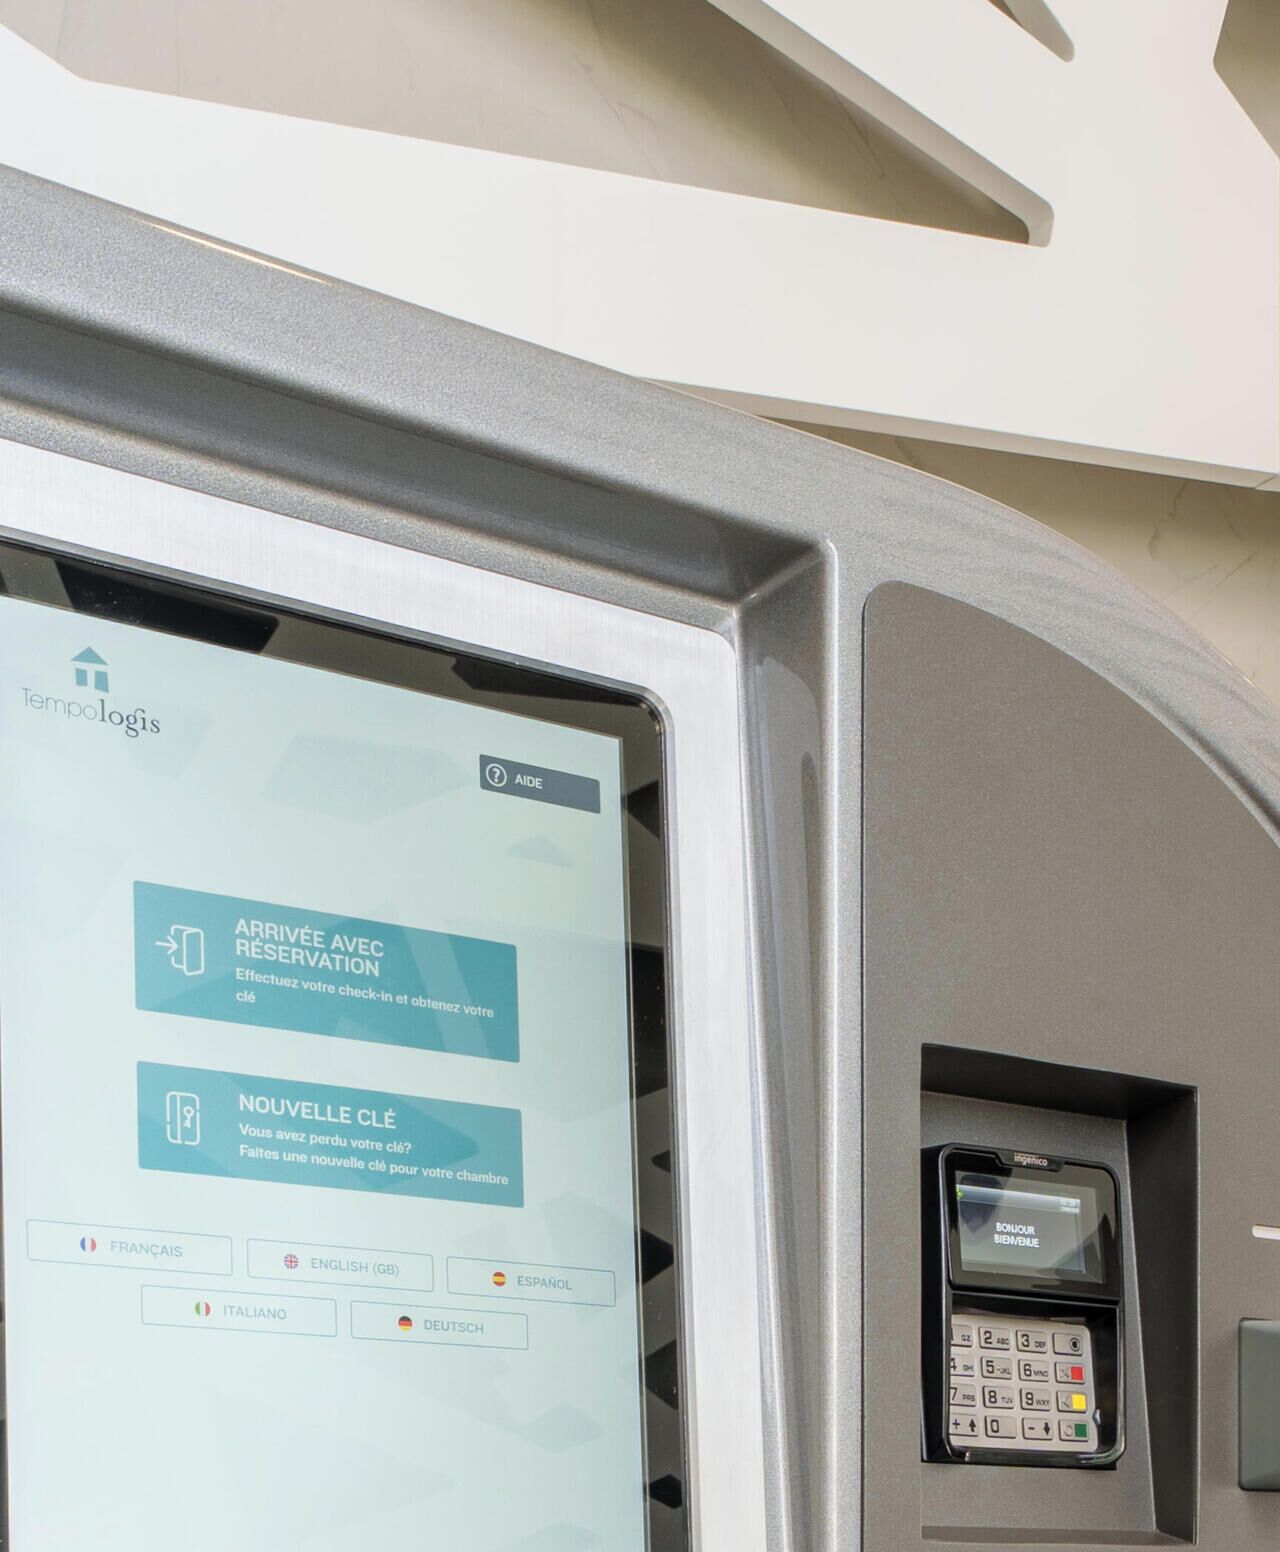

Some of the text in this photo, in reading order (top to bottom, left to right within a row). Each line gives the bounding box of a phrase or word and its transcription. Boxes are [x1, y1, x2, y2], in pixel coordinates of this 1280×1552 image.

[21, 687, 161, 738] Tempologis
[515, 774, 543, 789] AIDE
[234, 917, 384, 957] ARRIVÉE AVEC
[235, 938, 380, 977] RÉSERVATION
[235, 967, 494, 1018] Effectuez votre check-in et obtenez votre
[236, 990, 256, 1003] clé
[239, 1093, 396, 1129] NOUVELLE CLÉ
[239, 1123, 412, 1154] Vous avez perdu votre clé?
[239, 1144, 508, 1186] Faites une nouvelle clé pour votre chambre
[1013, 1152, 1048, 1166] ingenico
[995, 1222, 1035, 1235] BONJOUR
[110, 1240, 183, 1259] FRANÇAIS
[994, 1234, 1040, 1248] BIENVENUE
[310, 1257, 400, 1278] ENGLISH (GB)
[516, 1275, 573, 1291] ESPAÑOL
[223, 1304, 287, 1320] ITALIANO
[423, 1318, 484, 1334] DEUTSCH
[983, 1330, 993, 1345] 2
[996, 1337, 1010, 1345] ABC
[1021, 1333, 1030, 1348] 3
[950, 1357, 957, 1371] 4
[985, 1360, 995, 1374] 5
[1023, 1363, 1032, 1377] 6
[949, 1387, 958, 1401] 7
[988, 1390, 997, 1404] 8
[1025, 1391, 1034, 1406] 9
[990, 1418, 1000, 1433] 0
